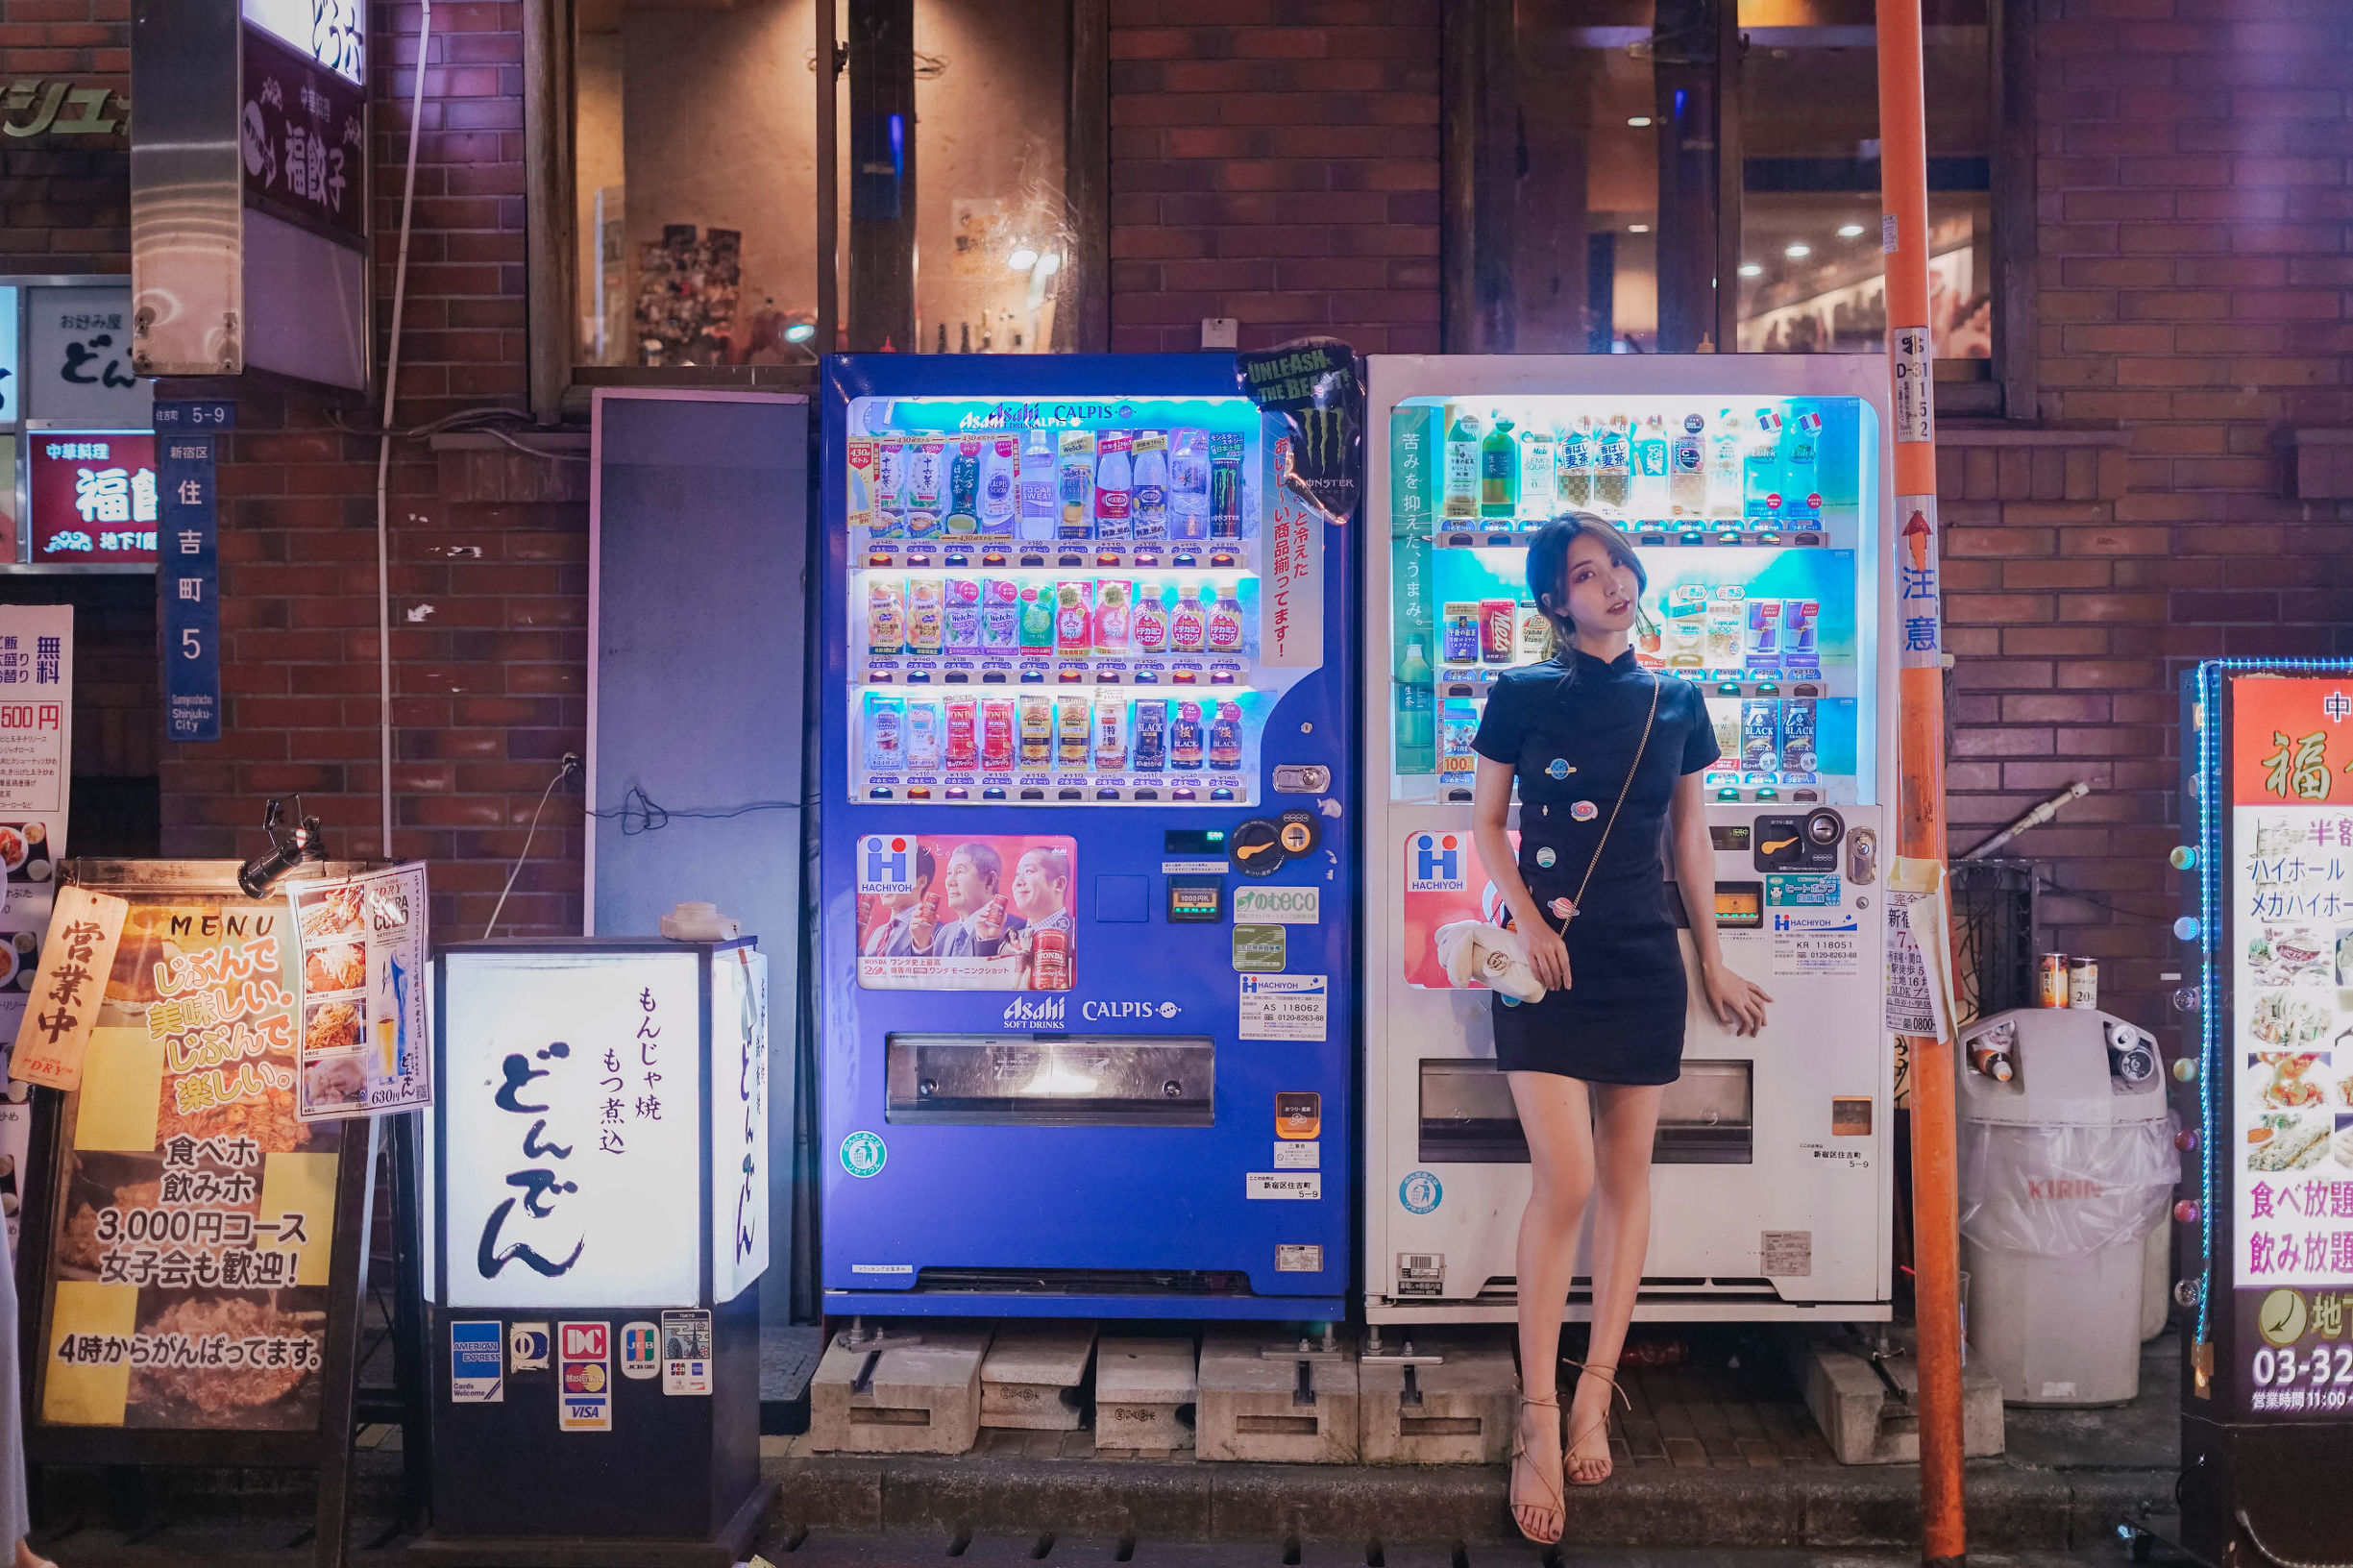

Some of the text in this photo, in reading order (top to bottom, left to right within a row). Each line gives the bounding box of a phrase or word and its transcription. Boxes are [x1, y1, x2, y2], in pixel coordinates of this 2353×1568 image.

[61, 313, 121, 330] お好み屋
[61, 333, 136, 388] どん
[1248, 349, 1330, 383] UNLEASH
[1258, 383, 1286, 403] THE
[156, 407, 225, 423] 住吉町 5-9
[1054, 404, 1113, 422] CALPIS
[46, 443, 110, 460] 中華料理
[170, 446, 208, 459] 新宿区
[1565, 452, 1589, 469] 麦茶
[1602, 452, 1625, 468] 麦茶
[923, 456, 932, 488] 十六茶
[1402, 432, 1422, 625] 苦みを抑えた、うまみ。
[1903, 565, 1938, 651] 注意
[1138, 634, 1161, 643] ストロング
[1175, 634, 1199, 643] ストロング
[1211, 634, 1235, 643] ストロング
[1490, 609, 1512, 652] Mets
[37, 636, 61, 684] 無料
[175, 720, 199, 733] City
[1138, 723, 1164, 732] BLACK
[1745, 726, 1774, 735] BLACK
[1785, 726, 1814, 736] BLACK
[2262, 730, 2353, 801] 福
[862, 884, 912, 893] HACHIYOH
[1412, 881, 1463, 890] HACHIYOH
[171, 915, 275, 938] MENU
[1037, 952, 1065, 962] WONDA
[154, 938, 279, 996] じぶんで
[37, 919, 106, 1044] 営業中
[147, 981, 294, 1041] 美味しい。
[1003, 995, 1153, 1021] Asahi CALPIS
[167, 1014, 291, 1073] じぶんで
[635, 987, 662, 1120] もんじゃ焼
[599, 1048, 625, 1155] もつ煮込
[166, 1135, 257, 1166] 食べホ
[1813, 1150, 1861, 1159] 新宿区住吉町
[478, 1041, 585, 1280] どんでん
[847, 1162, 882, 1176] リサイクル
[161, 1172, 255, 1203] 飲みホ
[1263, 1181, 1311, 1189] 新宿区住吉町
[2027, 1179, 2103, 1200] KIRIN
[97, 1210, 307, 1245] 3,000円コース
[100, 1249, 298, 1285] 女子会も歓迎!
[58, 1334, 320, 1368] 4時からがんばってます。
[453, 1341, 498, 1352] AMERICAN
[462, 1353, 501, 1361] EXPRESS
[2251, 1390, 2305, 1409] 営業時間
[572, 1407, 600, 1418] VISA
